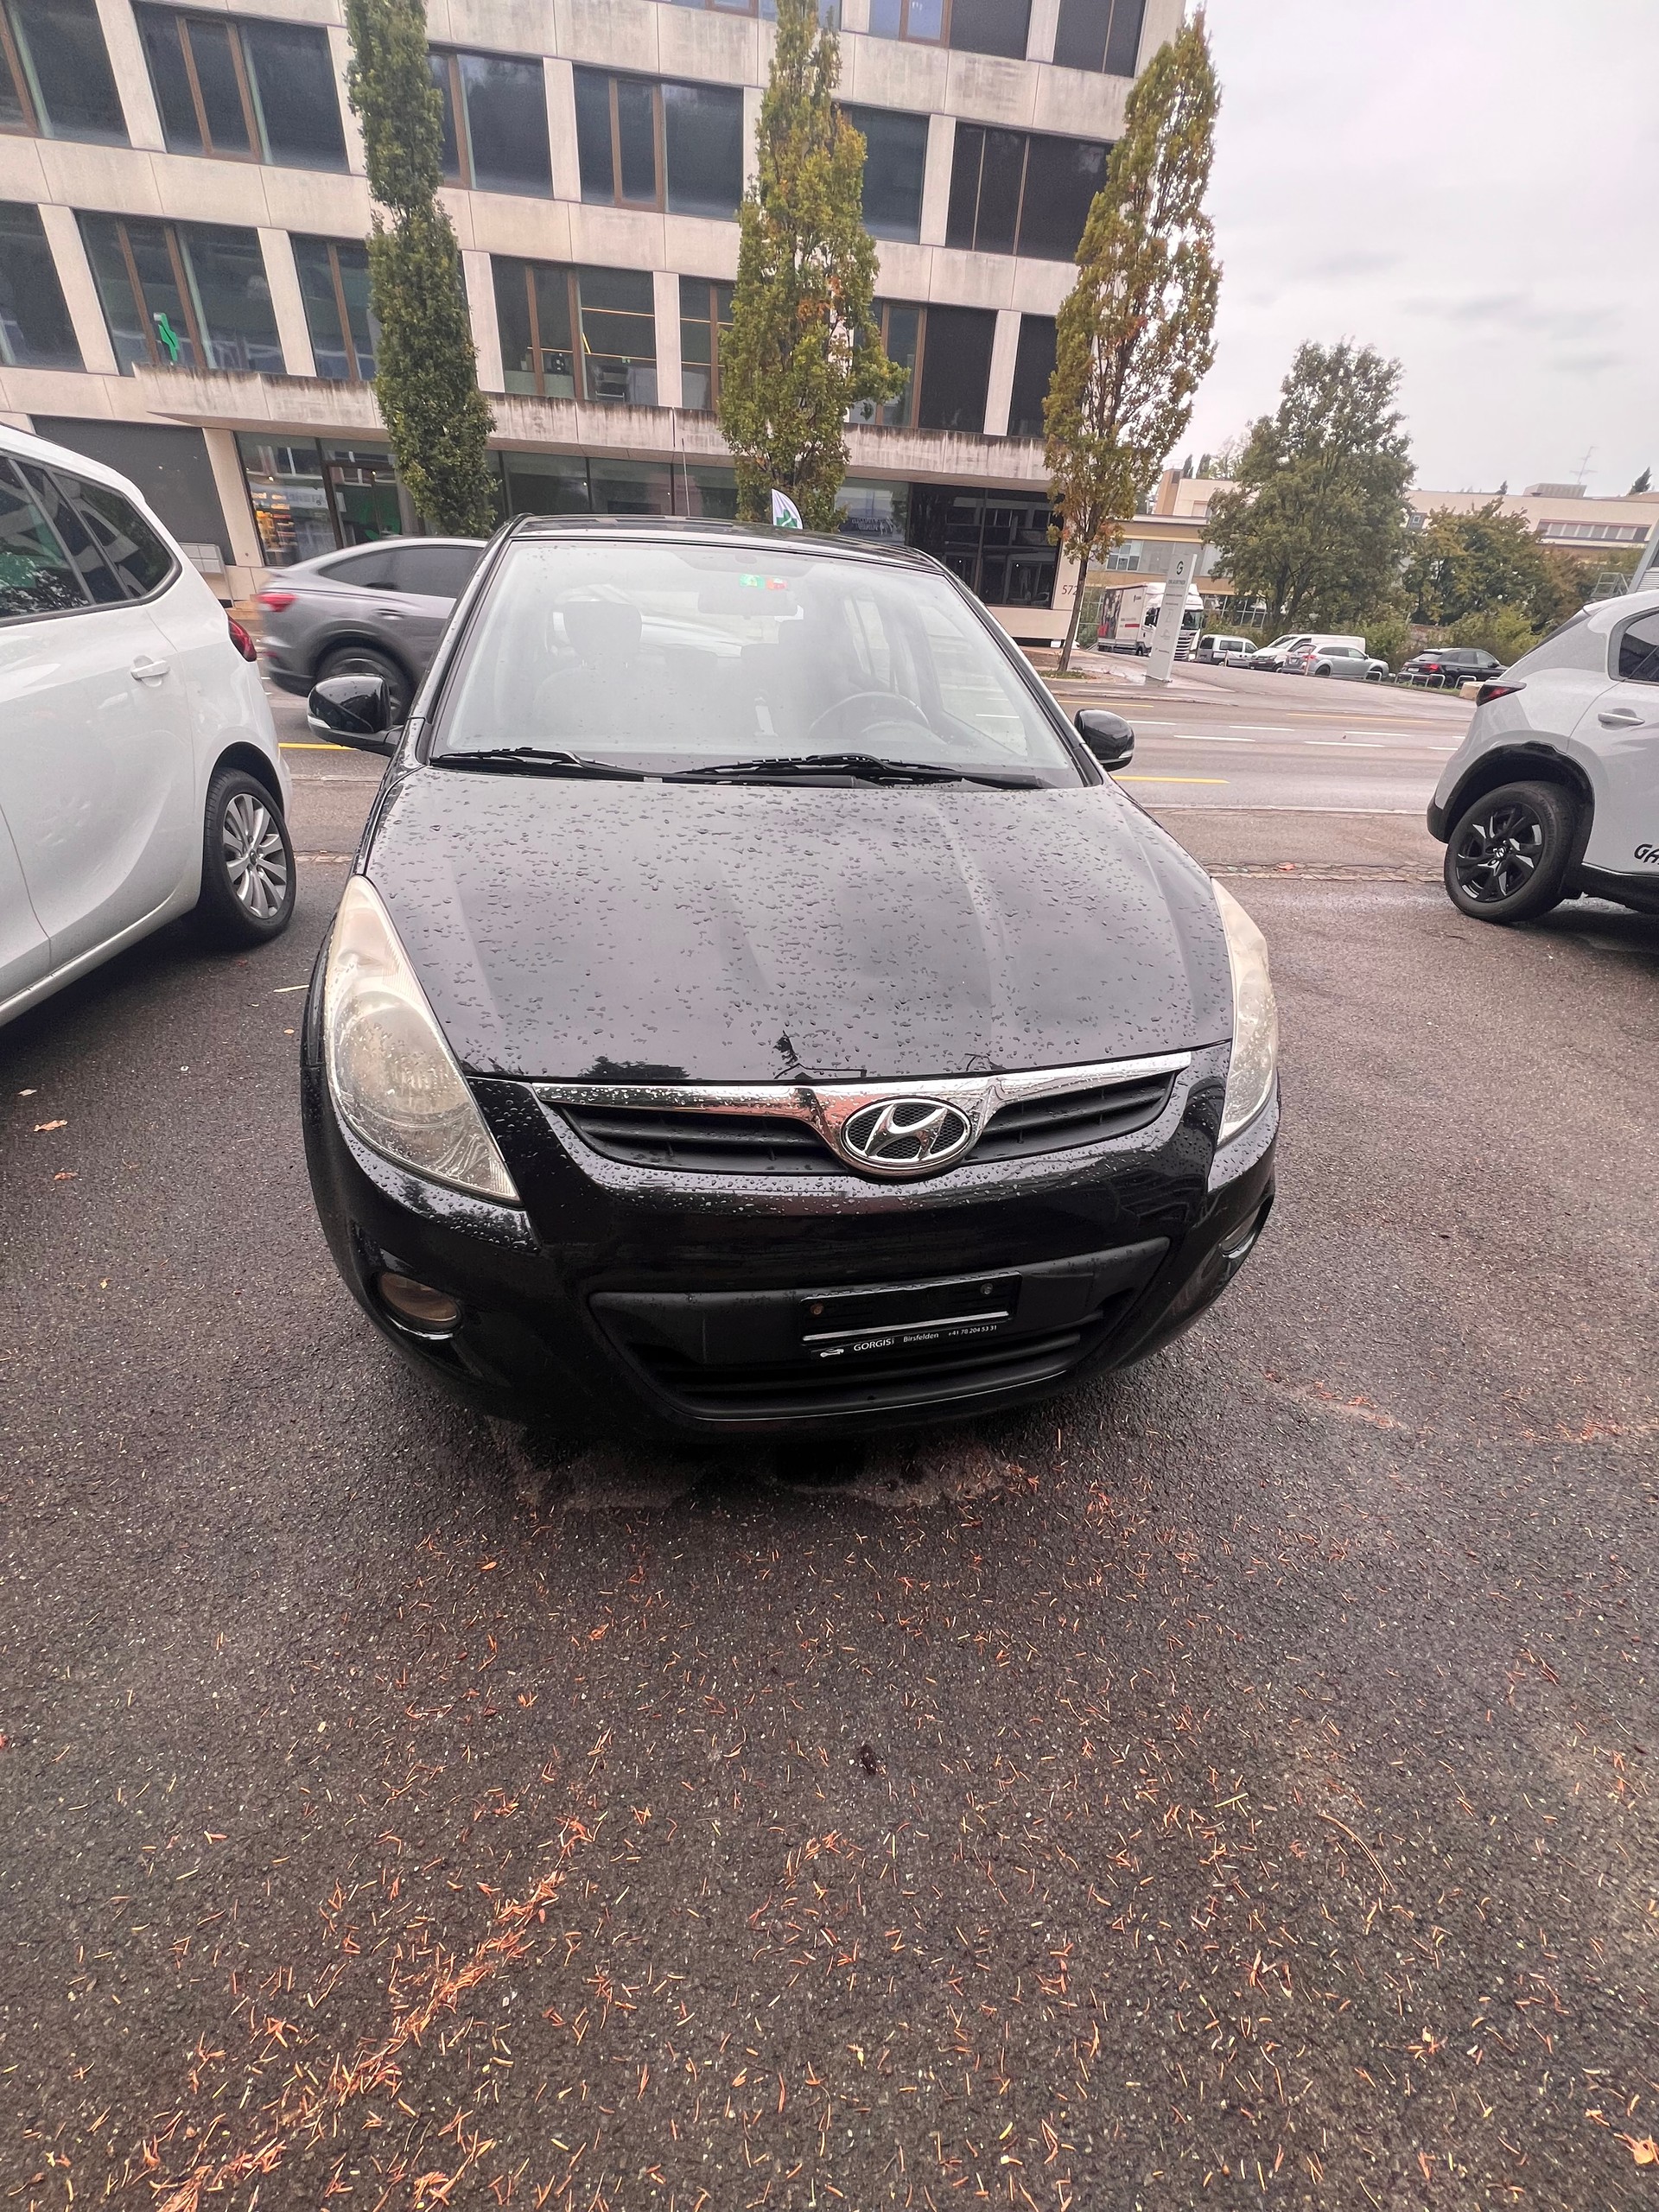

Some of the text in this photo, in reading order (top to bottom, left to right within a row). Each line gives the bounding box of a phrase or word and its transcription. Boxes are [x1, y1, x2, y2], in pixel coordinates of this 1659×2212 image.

[1634, 843, 1659, 865] GA
[854, 1338, 892, 1351] GORGIS
[903, 1332, 939, 1343] Birsfelden
